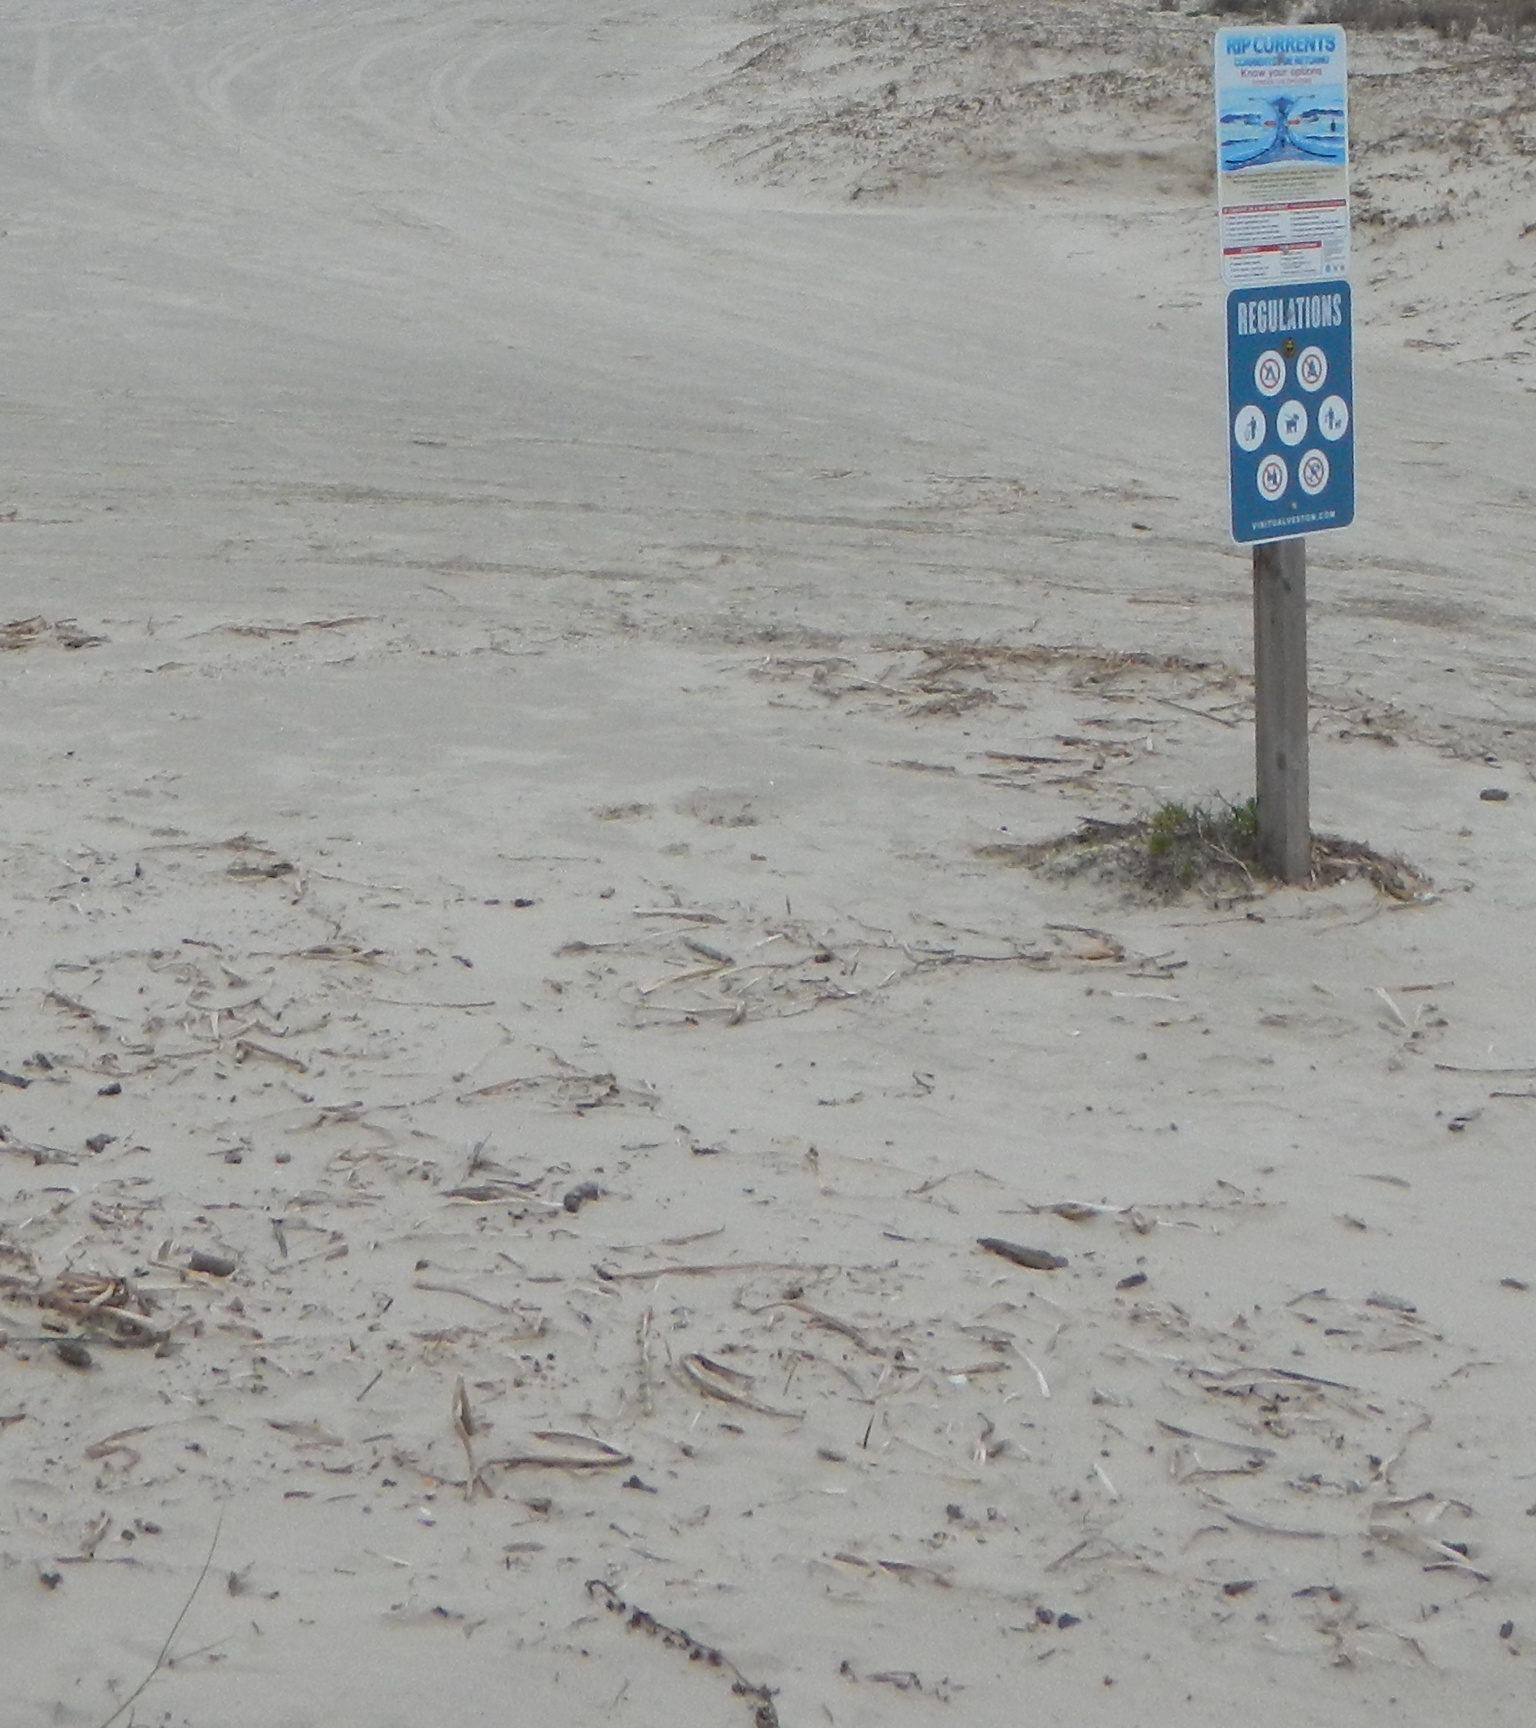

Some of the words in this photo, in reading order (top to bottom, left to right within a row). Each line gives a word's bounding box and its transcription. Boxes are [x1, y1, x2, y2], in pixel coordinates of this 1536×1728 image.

[1226, 35, 1251, 55] RIP
[1253, 33, 1336, 54] CURRENTS
[1240, 68, 1265, 78] Know
[1268, 69, 1287, 79] your
[1237, 293, 1342, 335] REGULATIONS
